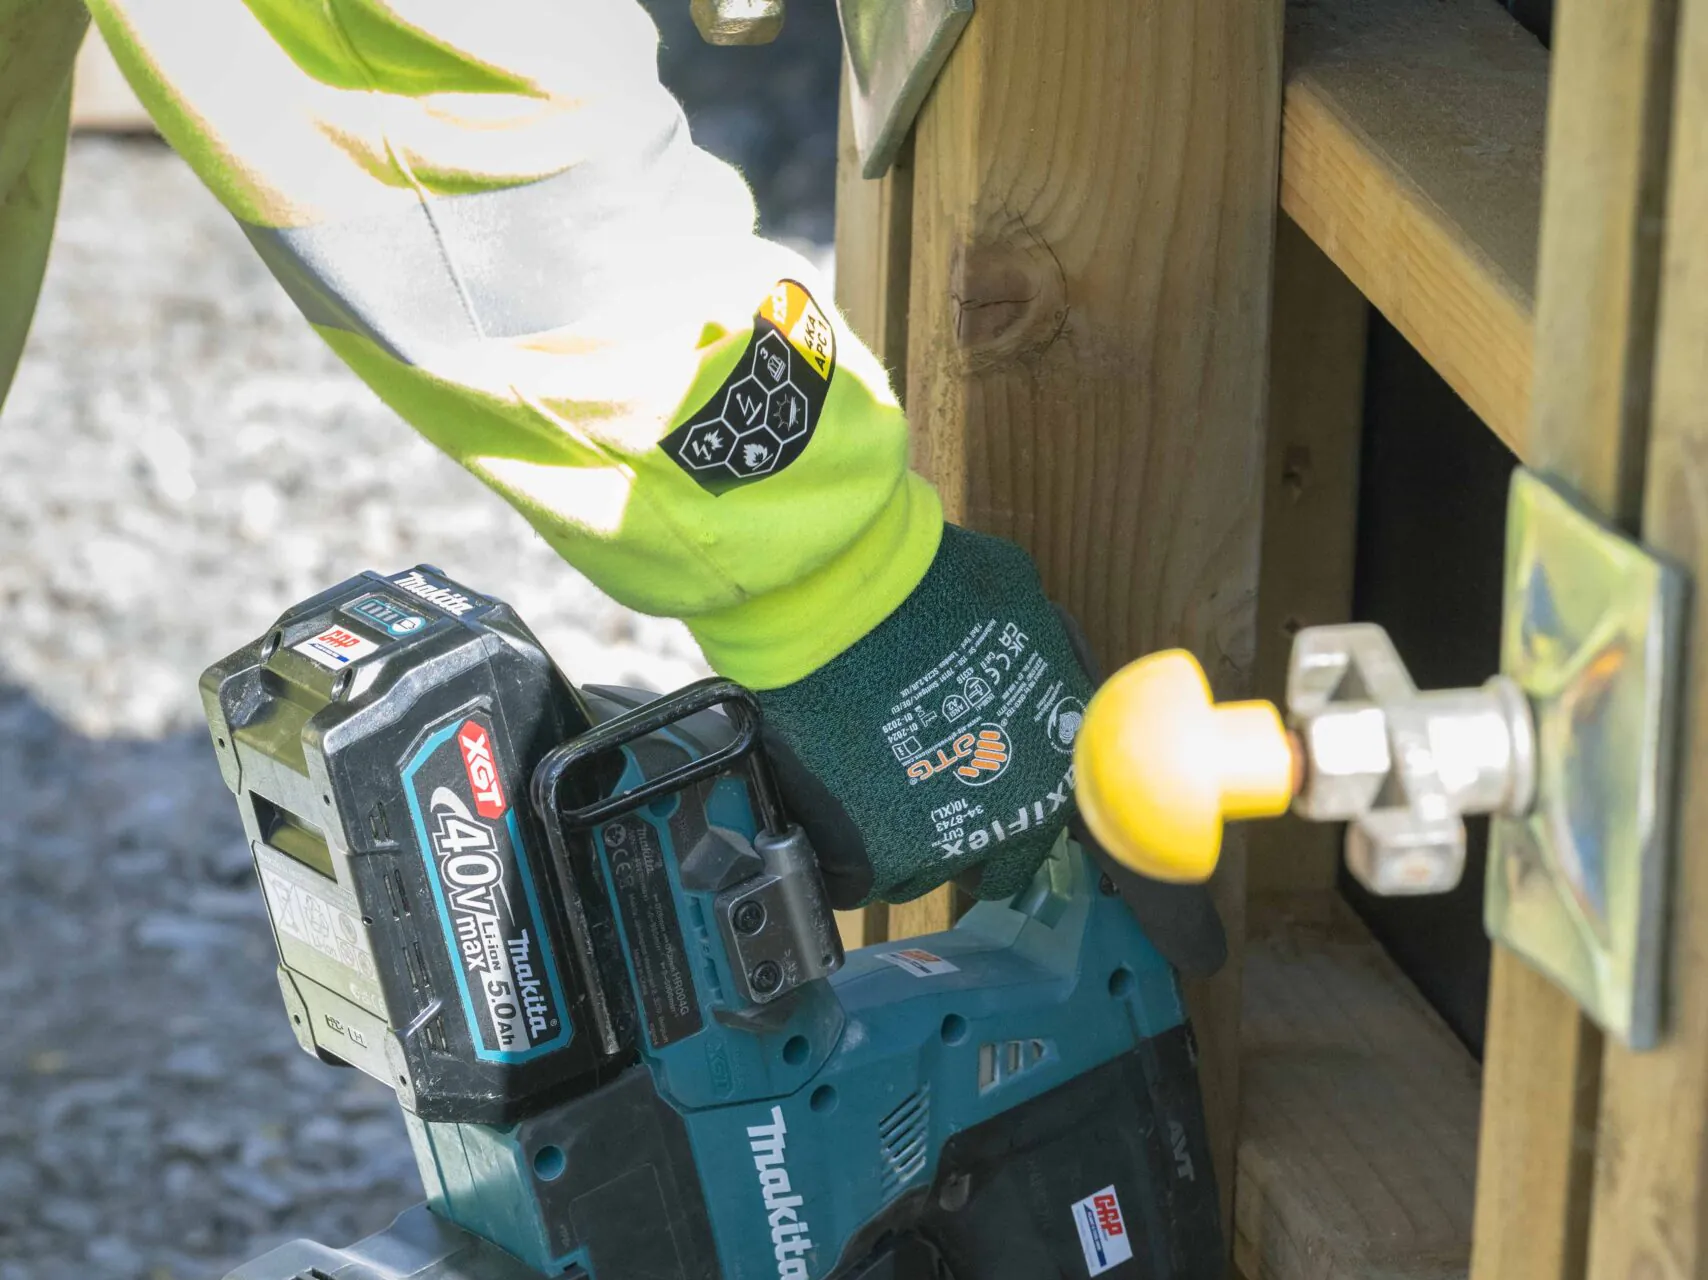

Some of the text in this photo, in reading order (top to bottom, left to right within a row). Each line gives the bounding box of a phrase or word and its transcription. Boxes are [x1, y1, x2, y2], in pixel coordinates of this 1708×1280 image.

[814, 333, 828, 371] APC
[945, 698, 958, 709] A2
[948, 703, 964, 716] ANSI
[886, 722, 918, 742] 01-2024
[459, 729, 505, 814] XGT
[928, 797, 968, 823] 10(XL)
[934, 804, 984, 833] 34-8743
[940, 762, 1075, 861] axiFlex
[455, 914, 489, 971] max
[485, 976, 517, 1046] 5.0Ah
[671, 971, 688, 1015] HR004G
[1167, 1121, 1195, 1179] AVT
[1093, 1194, 1123, 1235] GAP
